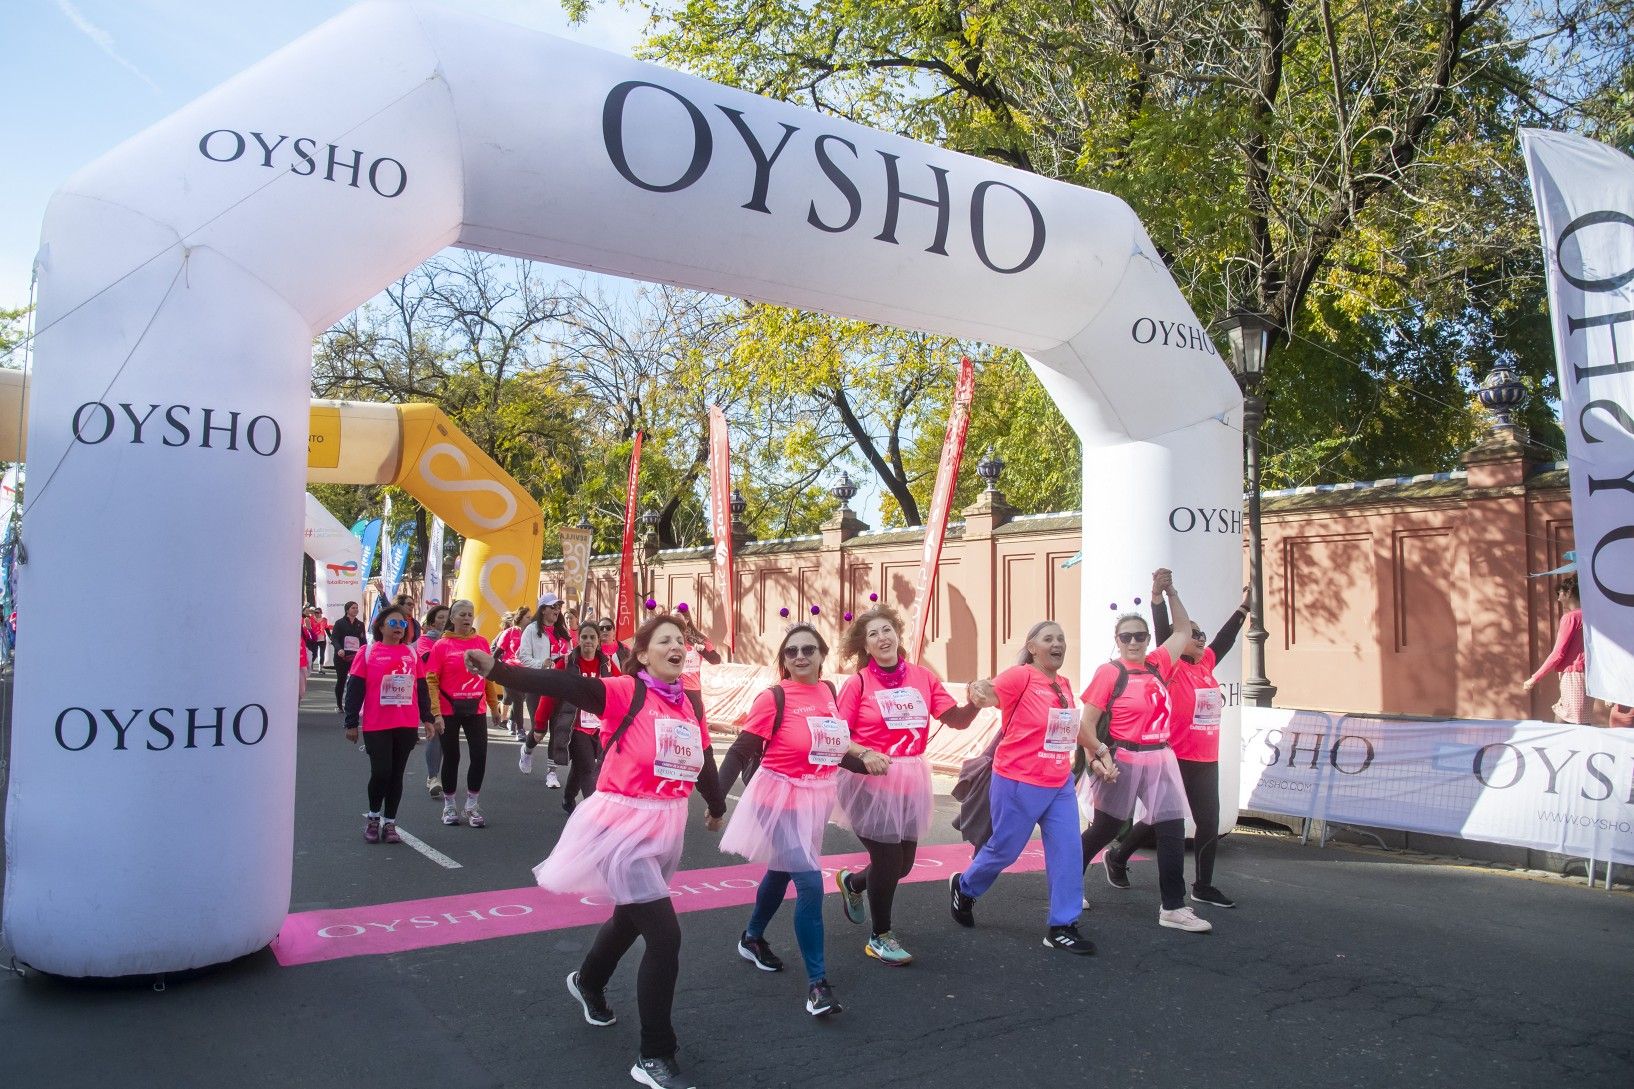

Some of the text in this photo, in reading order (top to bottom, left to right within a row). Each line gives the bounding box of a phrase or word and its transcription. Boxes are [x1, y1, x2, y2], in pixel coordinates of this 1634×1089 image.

[199, 129, 407, 198] OYSHO
[602, 80, 1046, 274] OYSHO
[72, 401, 281, 456] OYSHO
[1168, 506, 1243, 534] OYSH
[896, 702, 914, 711] 016
[54, 703, 269, 751] OYSHO
[826, 736, 841, 746] 016
[674, 744, 692, 757] 016
[317, 904, 533, 938] OYSHO
